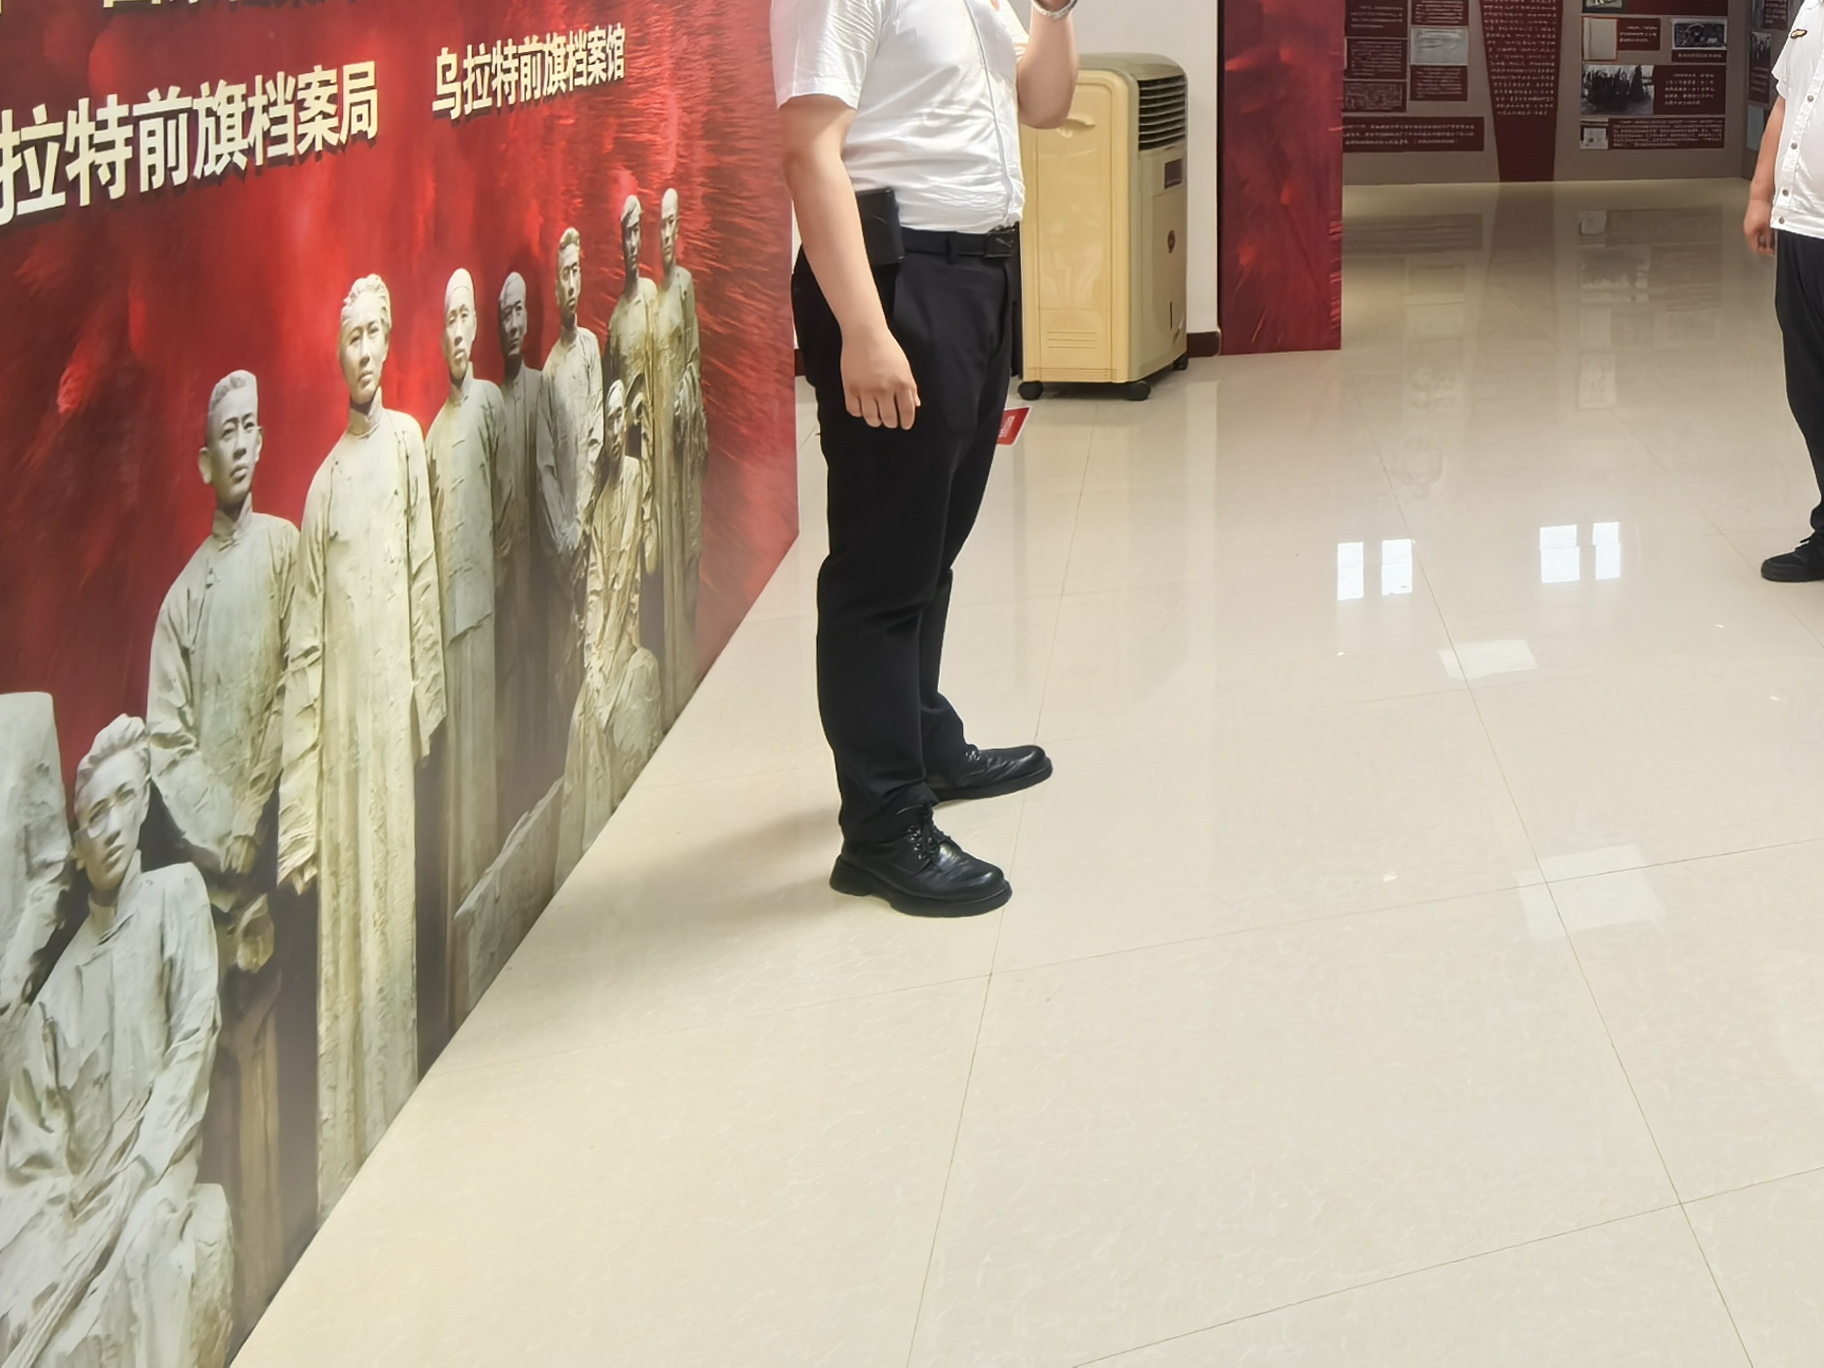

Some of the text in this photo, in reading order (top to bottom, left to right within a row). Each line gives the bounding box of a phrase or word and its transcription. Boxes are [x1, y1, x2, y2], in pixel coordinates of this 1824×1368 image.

[432, 22, 626, 120] 乌拉特前旗档案馆
